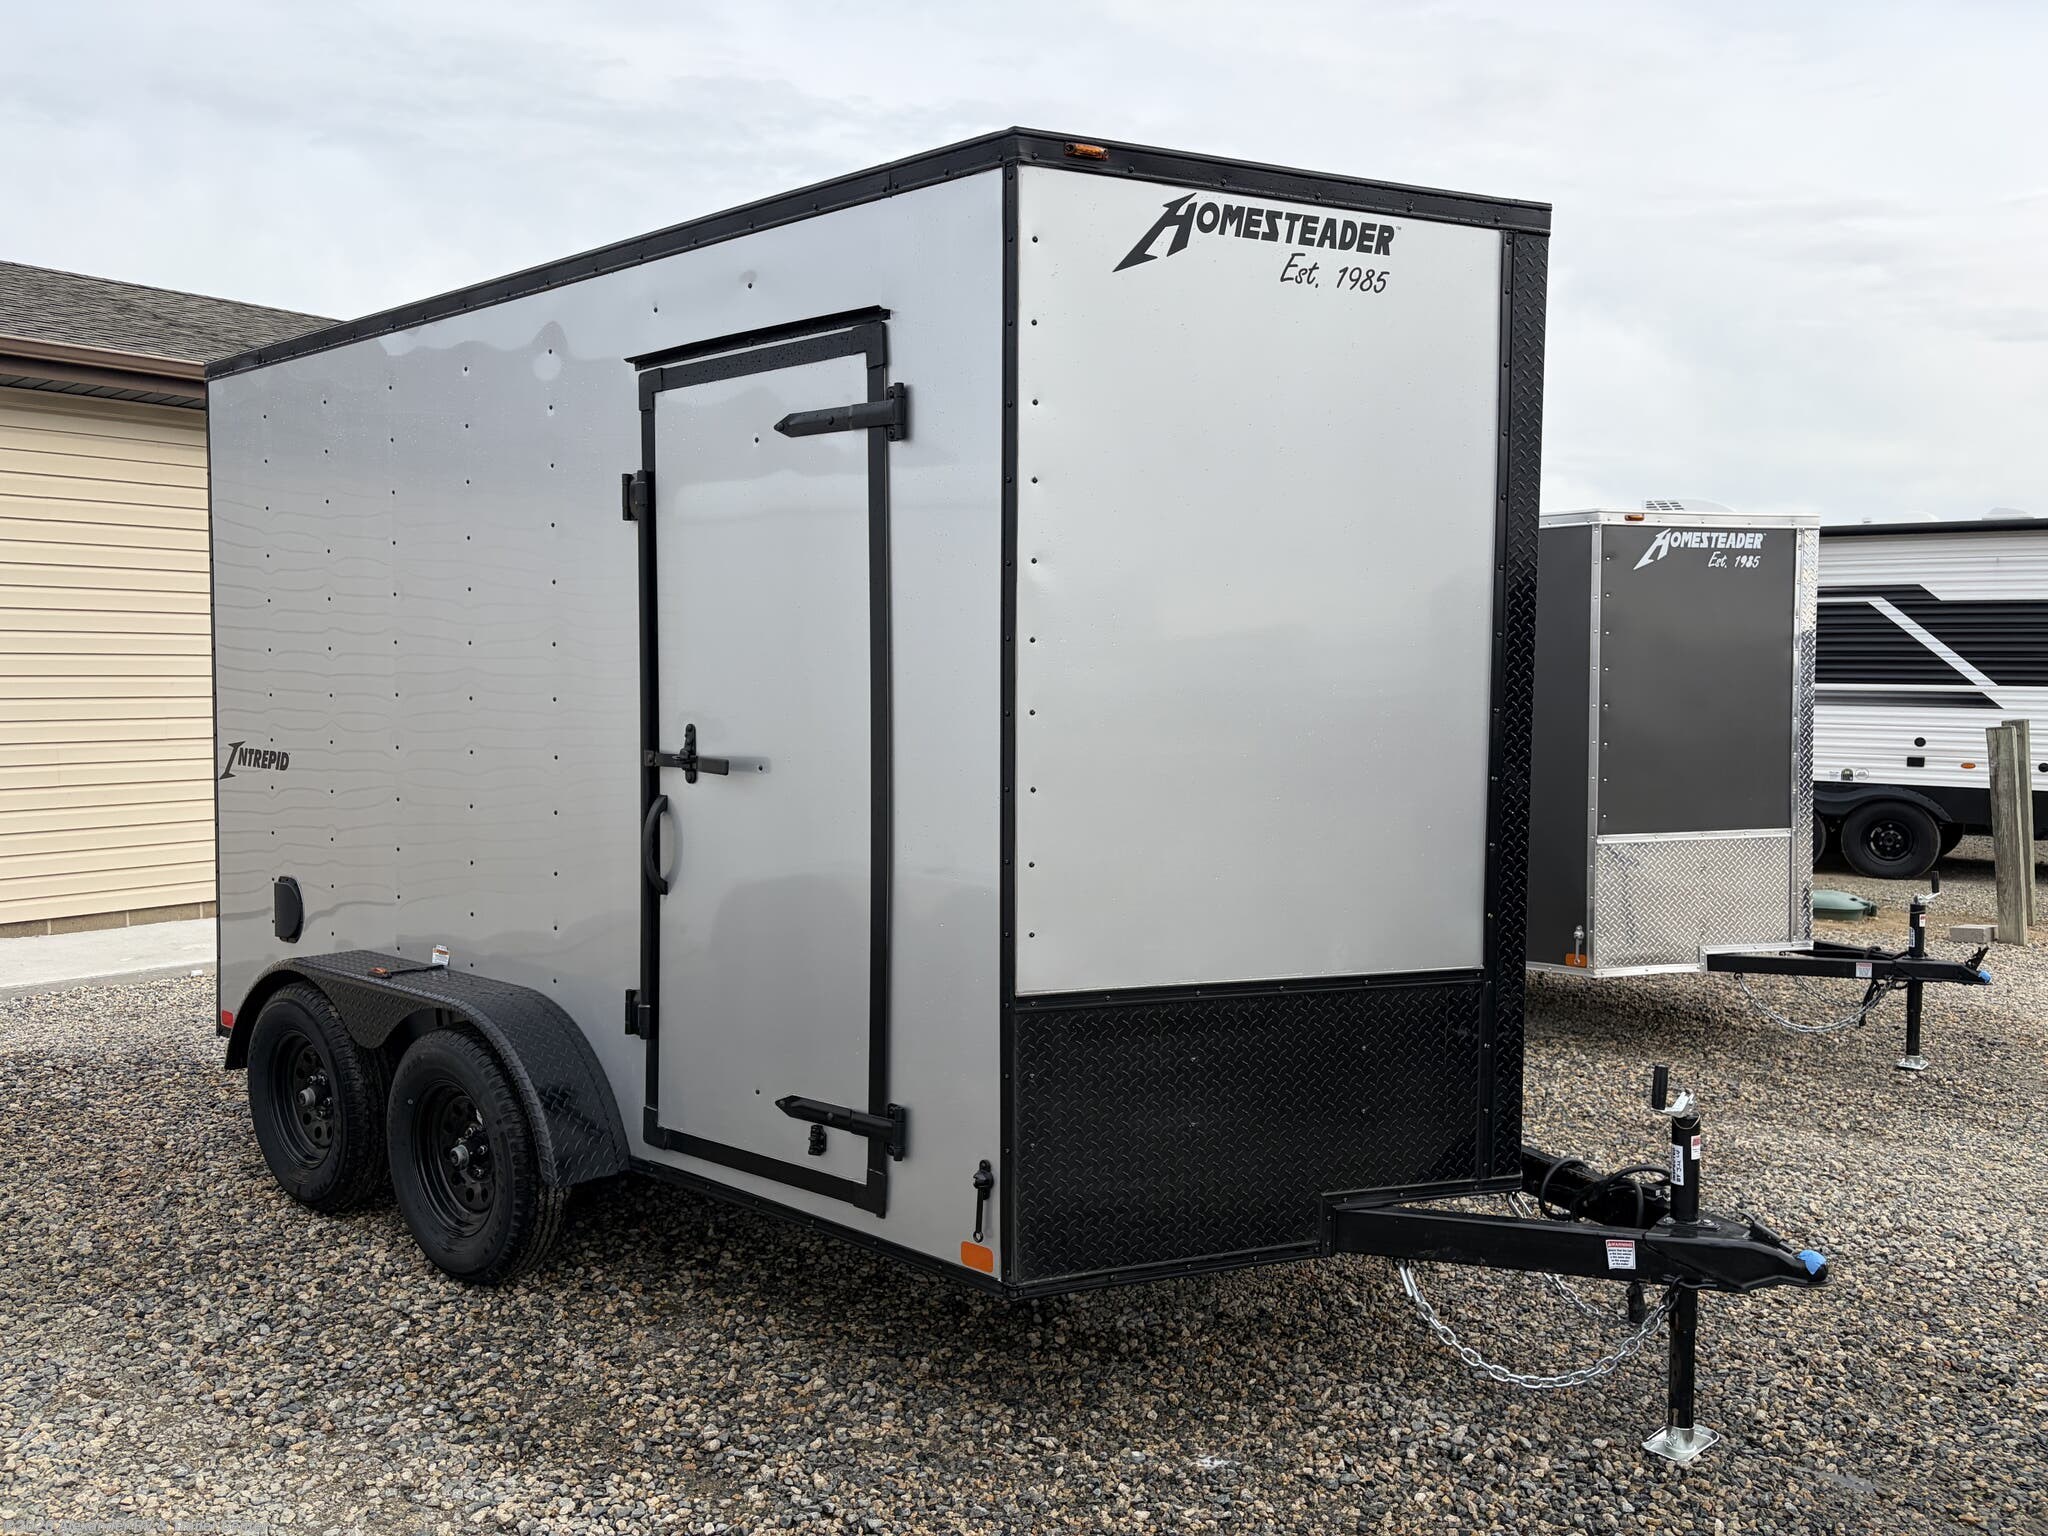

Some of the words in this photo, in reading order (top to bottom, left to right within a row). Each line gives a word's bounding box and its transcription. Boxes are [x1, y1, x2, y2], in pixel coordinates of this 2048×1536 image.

[1112, 192, 1395, 272] HOMESTEADER
[1280, 252, 1319, 288] Est.
[1336, 266, 1390, 293] 1985
[1633, 528, 1764, 570] HOMESTEADER
[1707, 551, 1728, 568] Est.
[1734, 555, 1761, 568] 1985
[219, 741, 290, 780] INTREPID
